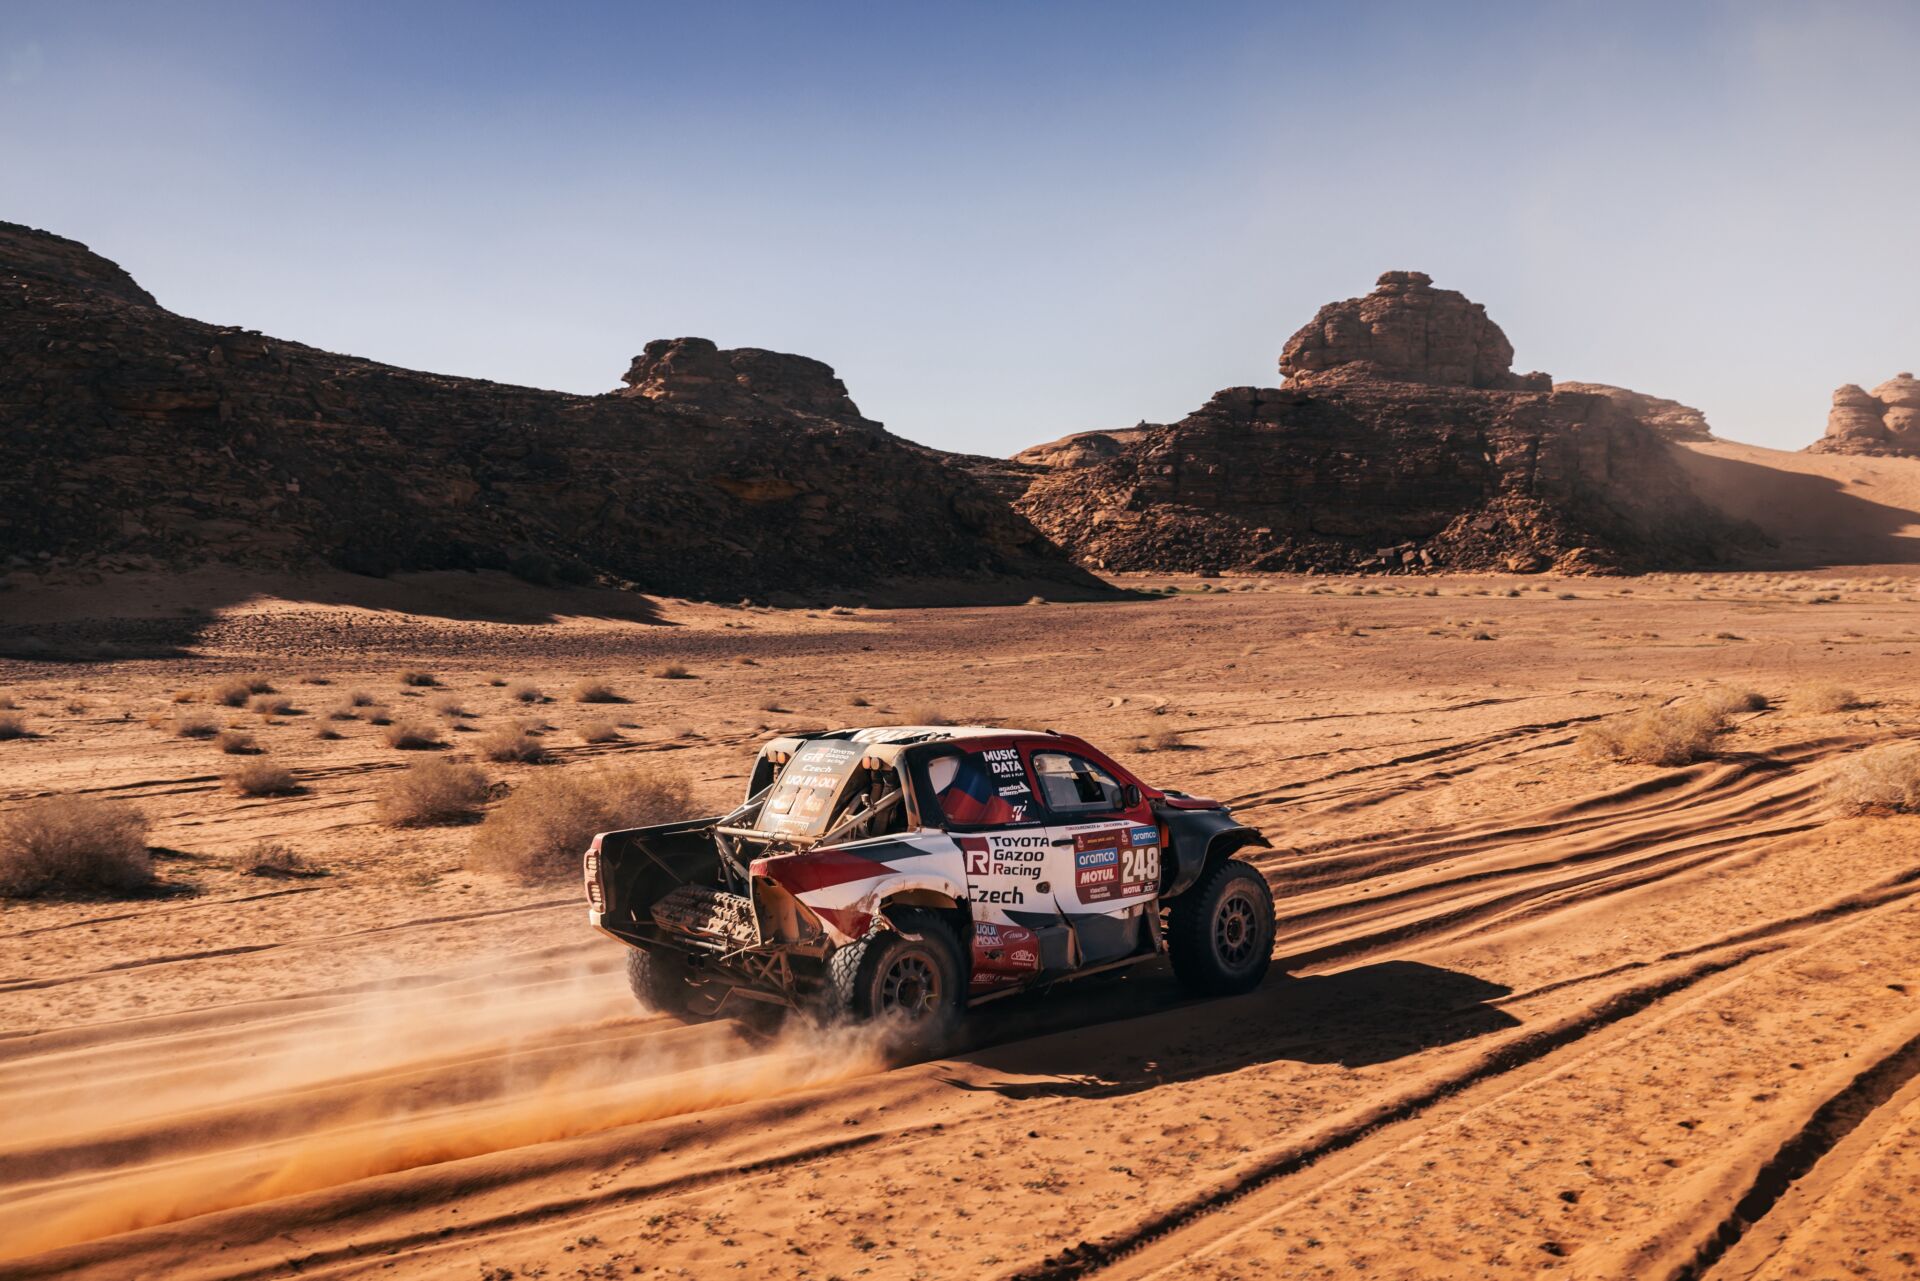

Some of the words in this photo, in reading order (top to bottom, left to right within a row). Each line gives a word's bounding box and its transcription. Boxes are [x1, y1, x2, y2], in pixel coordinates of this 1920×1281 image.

[802, 751, 824, 763] GR
[983, 749, 1019, 762] MUSIC
[802, 764, 833, 773] Czech
[992, 761, 1023, 774] DATA
[990, 836, 1050, 848] TOYOTA
[1132, 831, 1157, 841] aramco
[993, 849, 1044, 862] GAZOO
[1079, 851, 1115, 866] aramco
[993, 863, 1042, 880] Racing
[1122, 847, 1159, 884] 248
[1080, 868, 1115, 884] MOTUL
[1123, 885, 1141, 895] MOTUL
[975, 923, 997, 935] LIQUI
[976, 935, 1000, 945] MOLY
